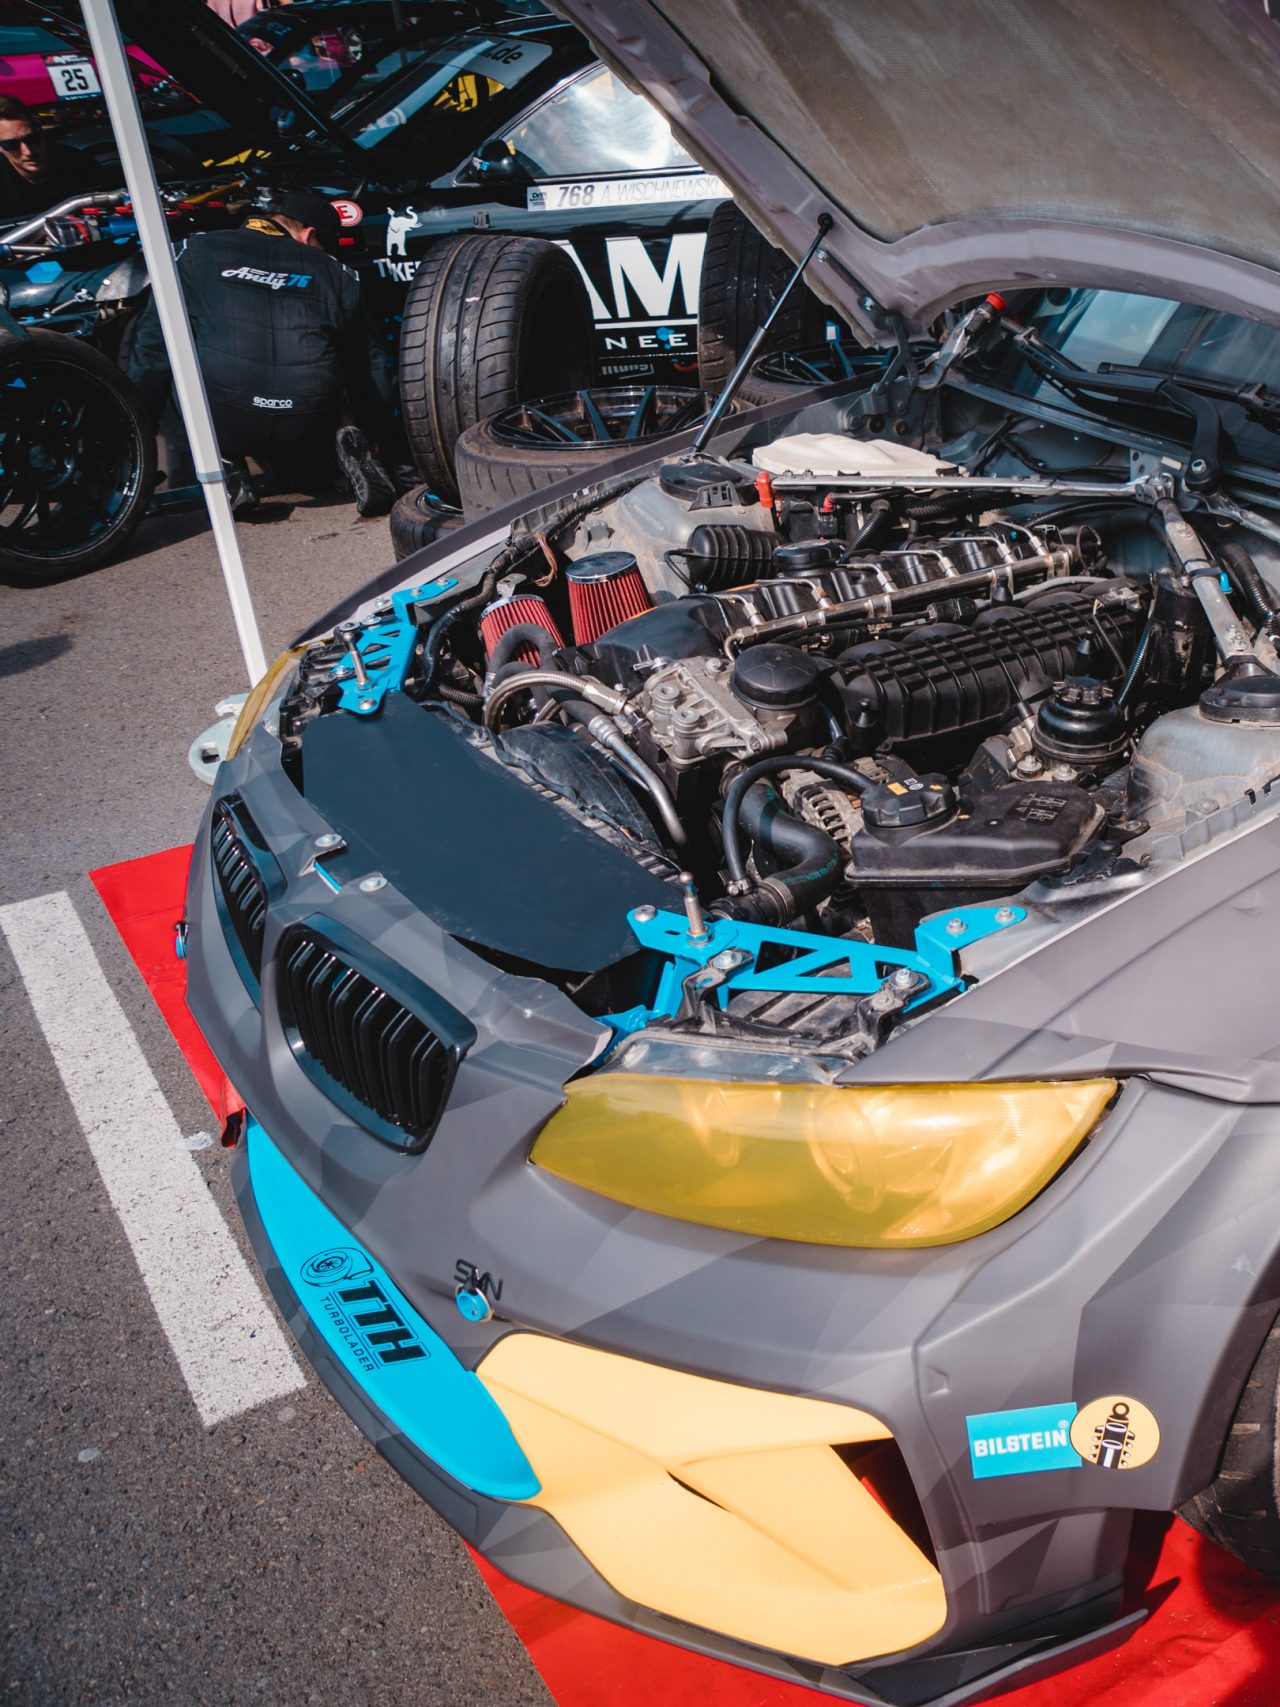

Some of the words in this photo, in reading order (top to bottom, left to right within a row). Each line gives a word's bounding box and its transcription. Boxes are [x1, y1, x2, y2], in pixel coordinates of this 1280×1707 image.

[61, 68, 89, 92] 25
[558, 184, 595, 208] 768
[618, 177, 719, 202] WISCHNEWSKI
[604, 333, 689, 350] NEE
[319, 1296, 374, 1373] TURBOLADER
[337, 1279, 428, 1364] TTH
[973, 1429, 1068, 1458] BILSTEIN
